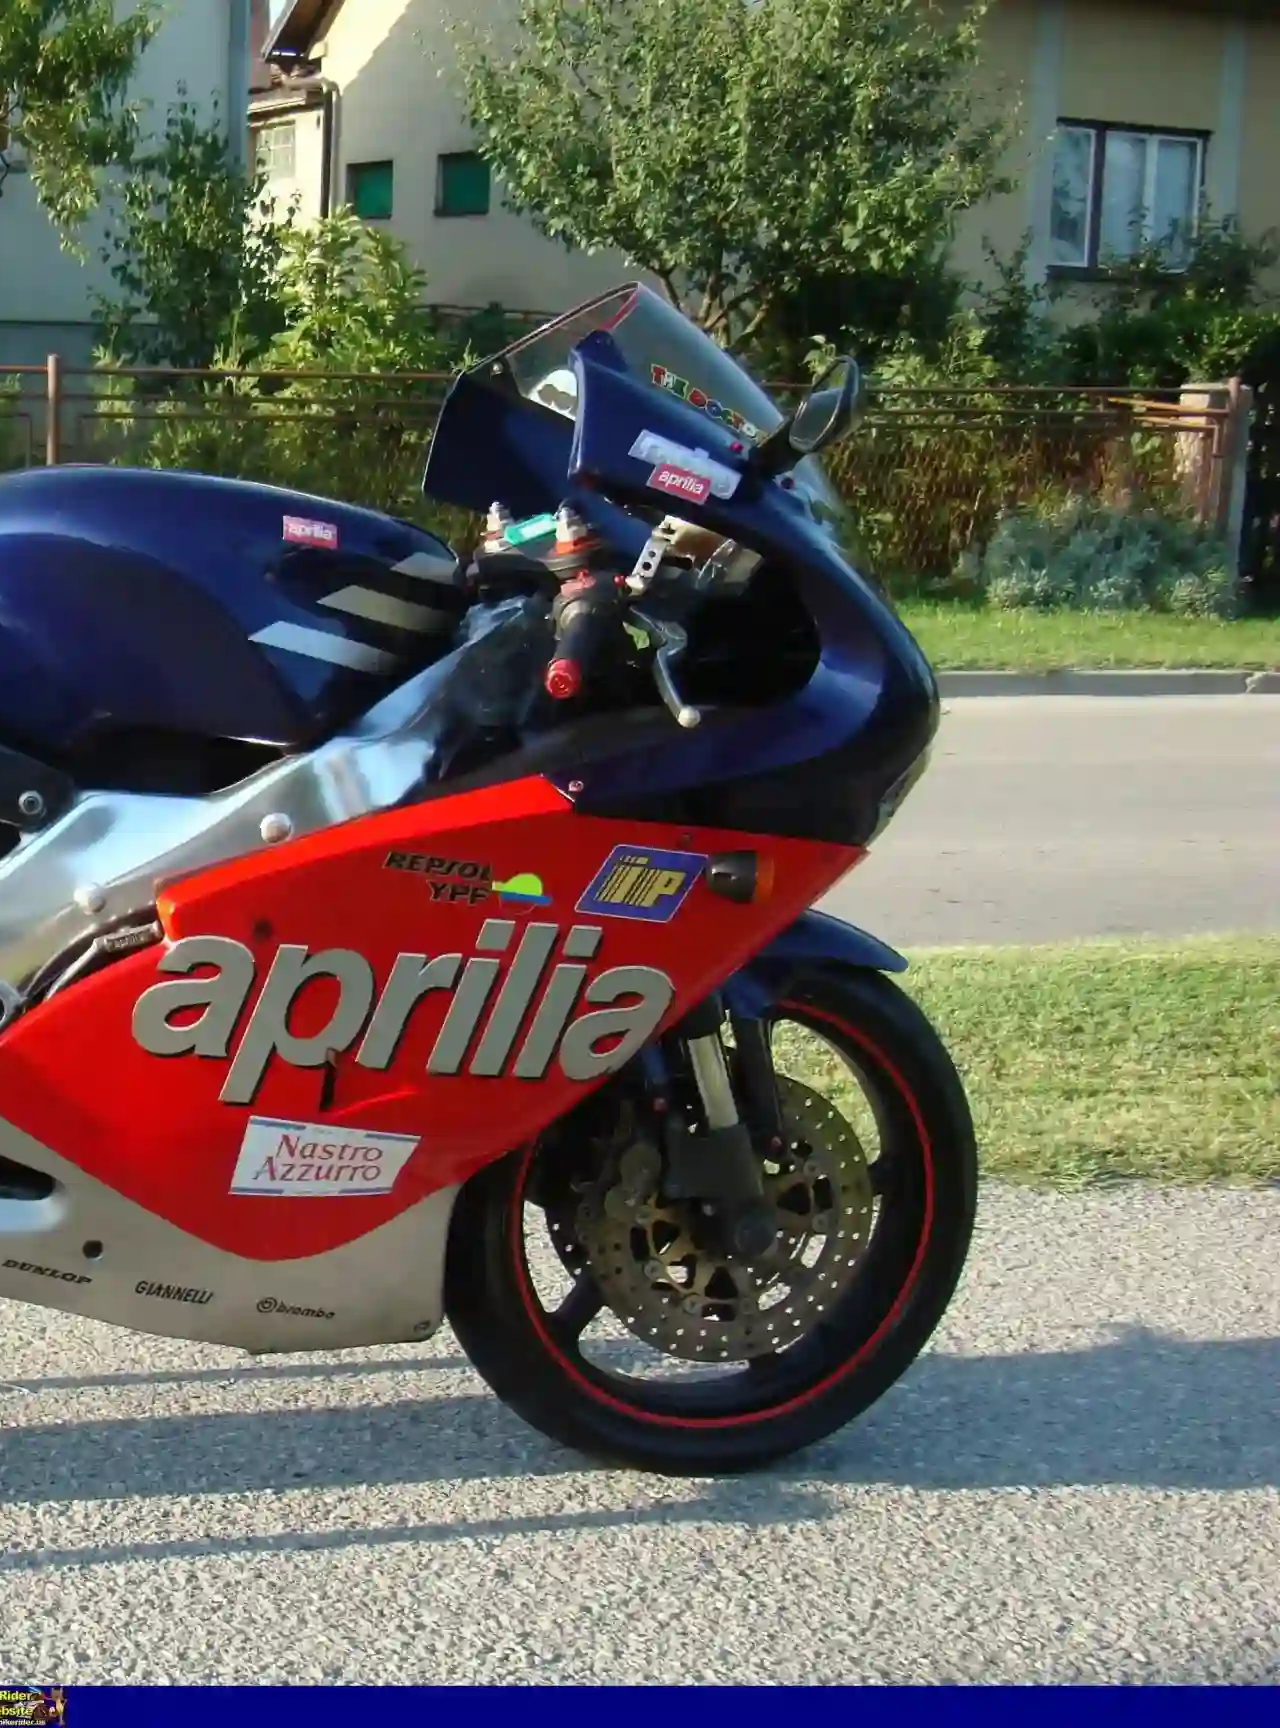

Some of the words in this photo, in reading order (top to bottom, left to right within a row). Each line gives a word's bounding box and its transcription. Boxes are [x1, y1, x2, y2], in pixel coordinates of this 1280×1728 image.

[658, 470, 704, 495] aprilia
[425, 879, 489, 906] YPF
[131, 919, 676, 1104] aprilia
[275, 1133, 383, 1162] Nastro
[252, 1155, 381, 1182] Azzurro
[1, 1258, 93, 1285] DUNLOP
[134, 1280, 215, 1305] GIANNELLI
[273, 1298, 336, 1320] brembo
